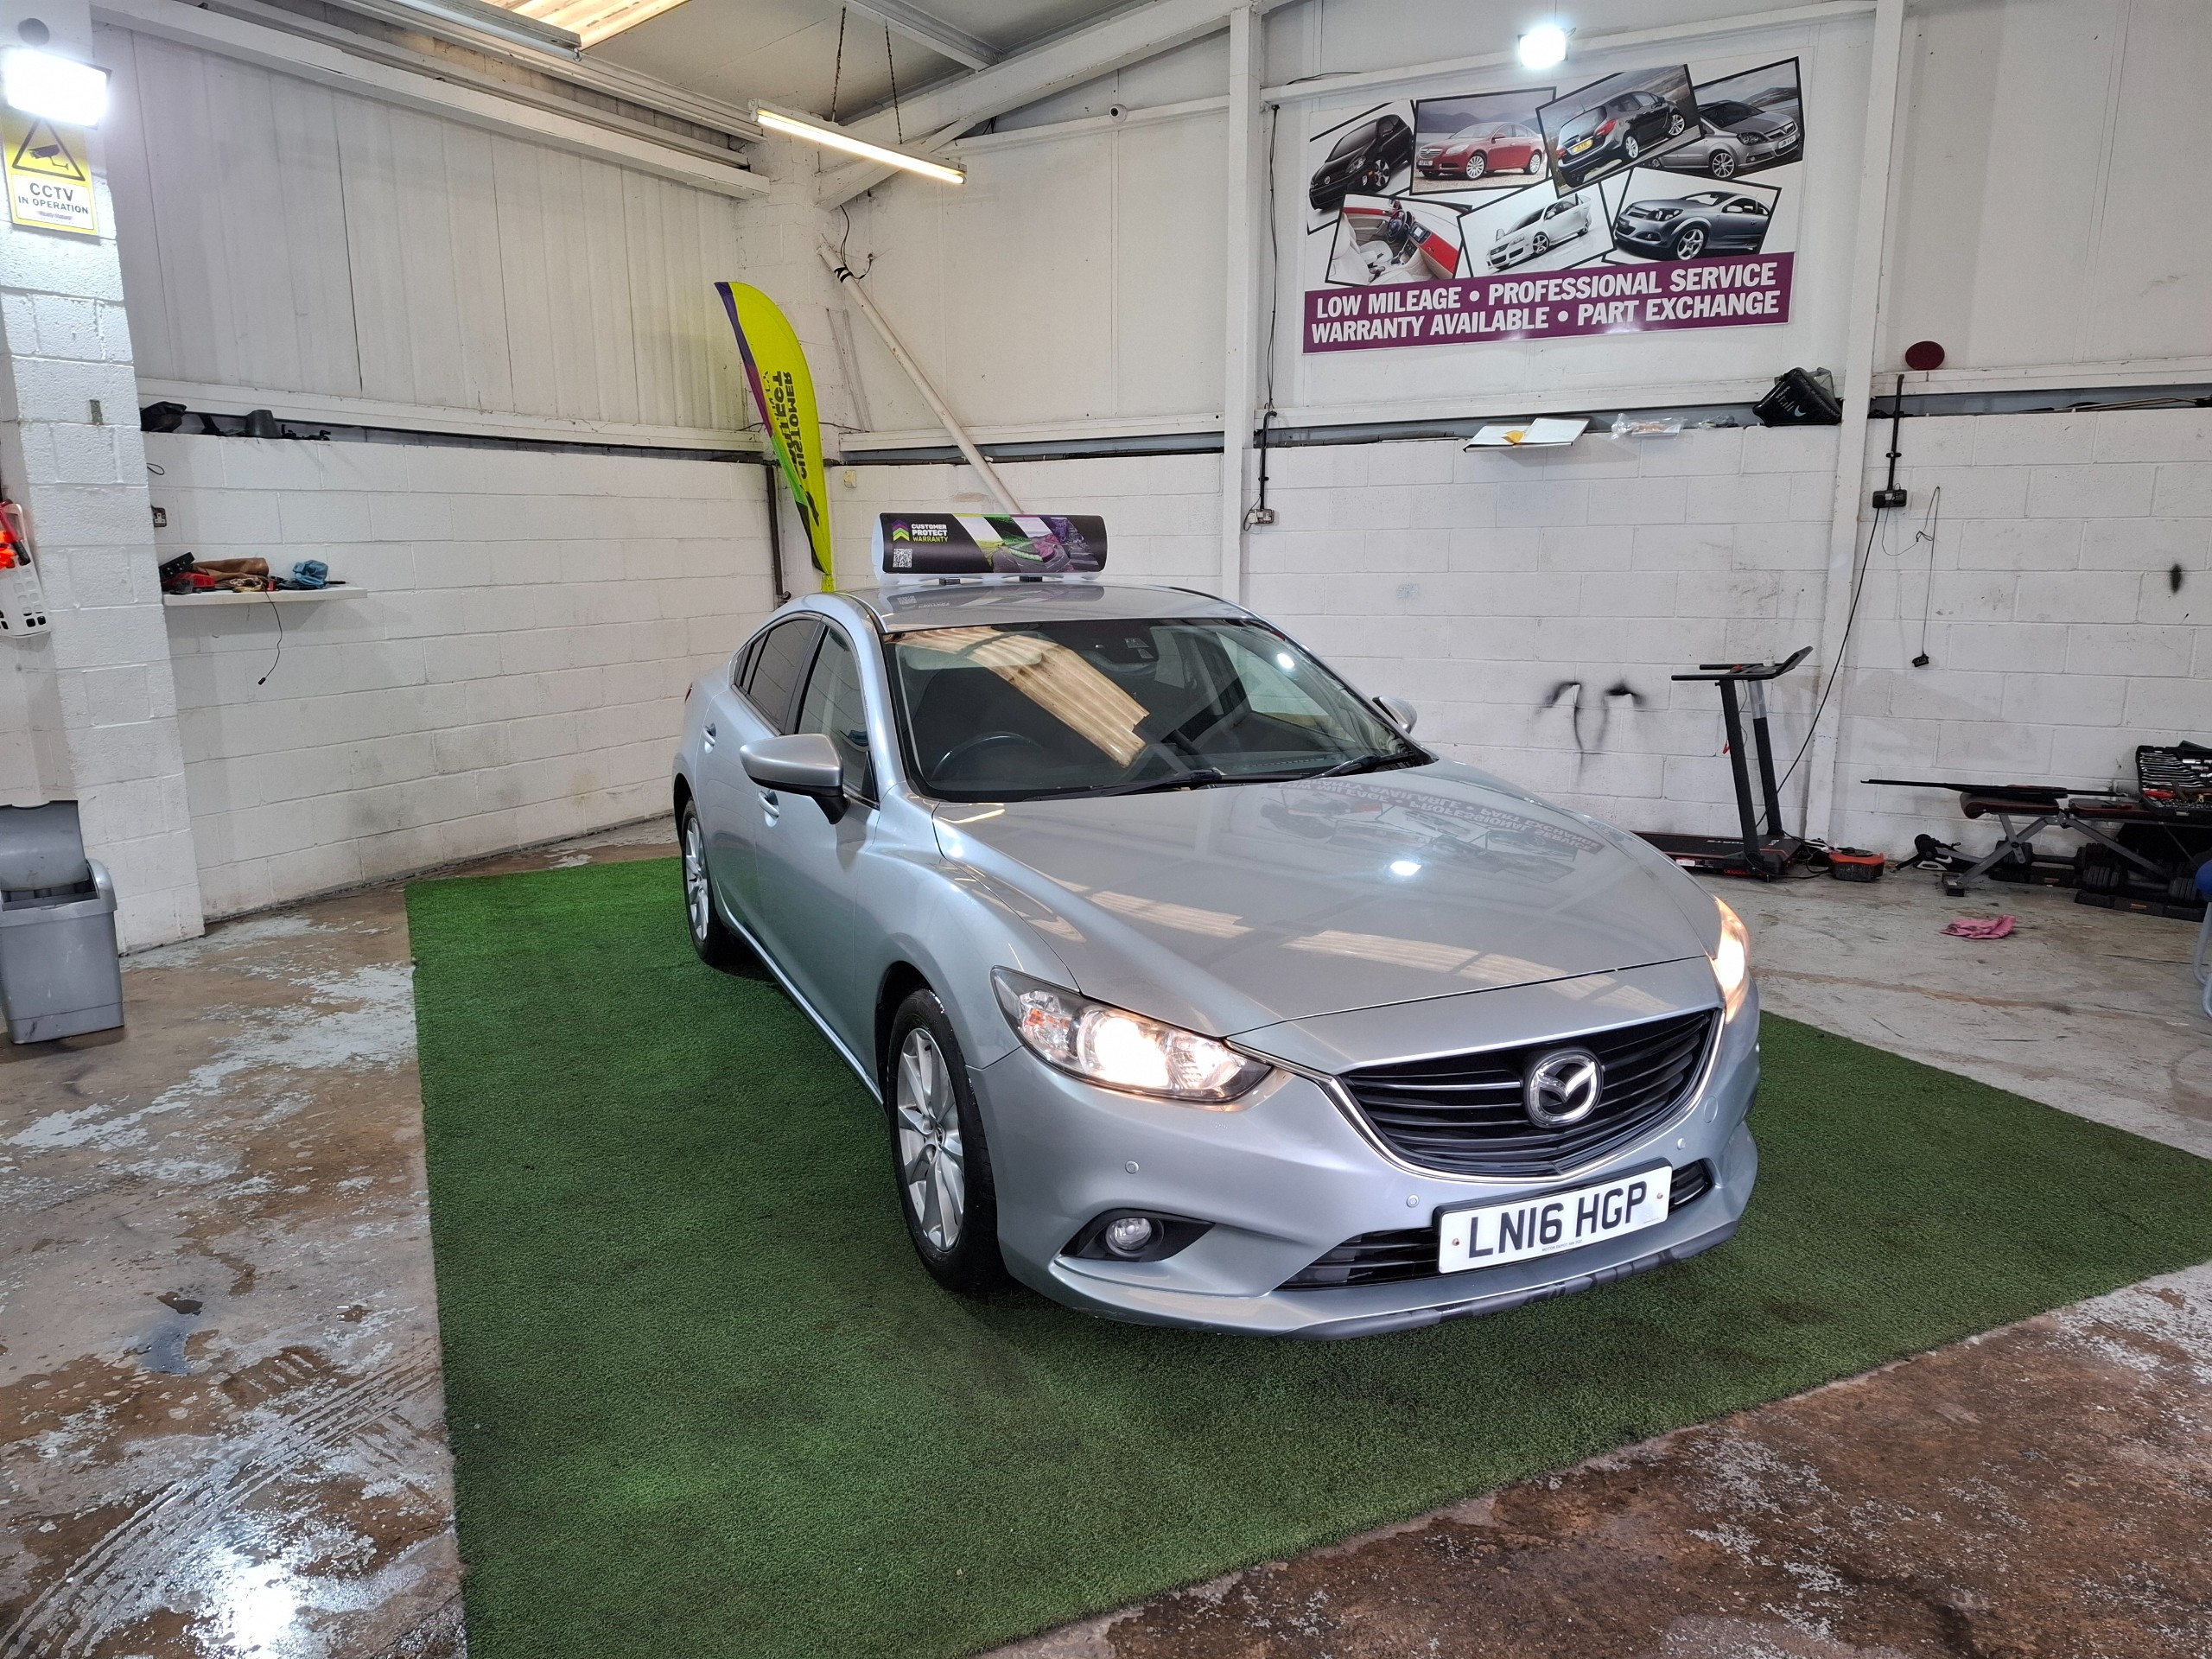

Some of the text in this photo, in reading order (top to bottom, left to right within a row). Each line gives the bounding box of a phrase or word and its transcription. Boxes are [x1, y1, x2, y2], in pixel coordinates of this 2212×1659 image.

[18, 195, 89, 214] IN OPERATION
[29, 182, 73, 201] CCTV
[1312, 290, 1781, 344] WARRANTY AVAILABLE PART EXCHANGE
[1317, 262, 1777, 319] LOW MILEAGE PROFESSIONAL SERVICE
[1469, 1180, 1648, 1259] LN16 HGP
